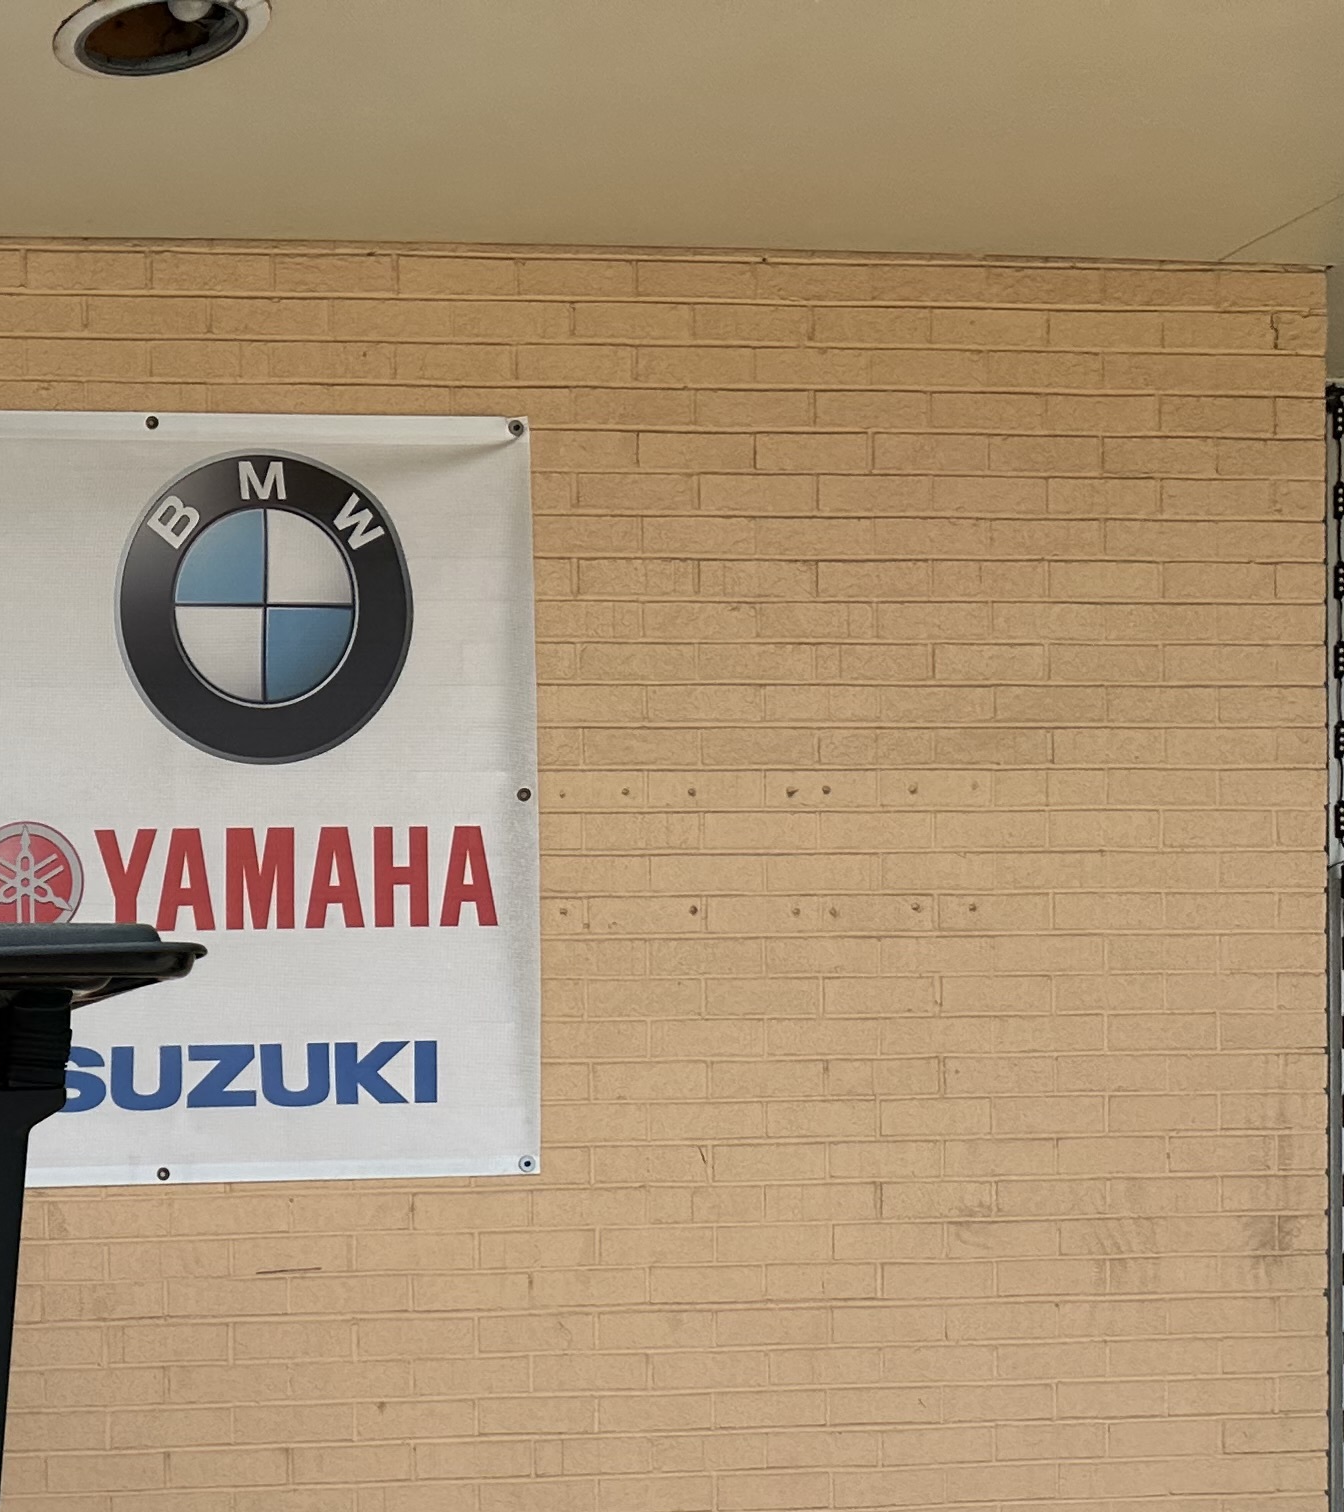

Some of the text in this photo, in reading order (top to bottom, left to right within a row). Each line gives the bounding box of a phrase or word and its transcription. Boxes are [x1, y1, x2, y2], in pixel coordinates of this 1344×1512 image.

[146, 460, 385, 550] BMW
[93, 825, 499, 932] YAMAHA
[58, 1039, 438, 1113] SUZUKI
